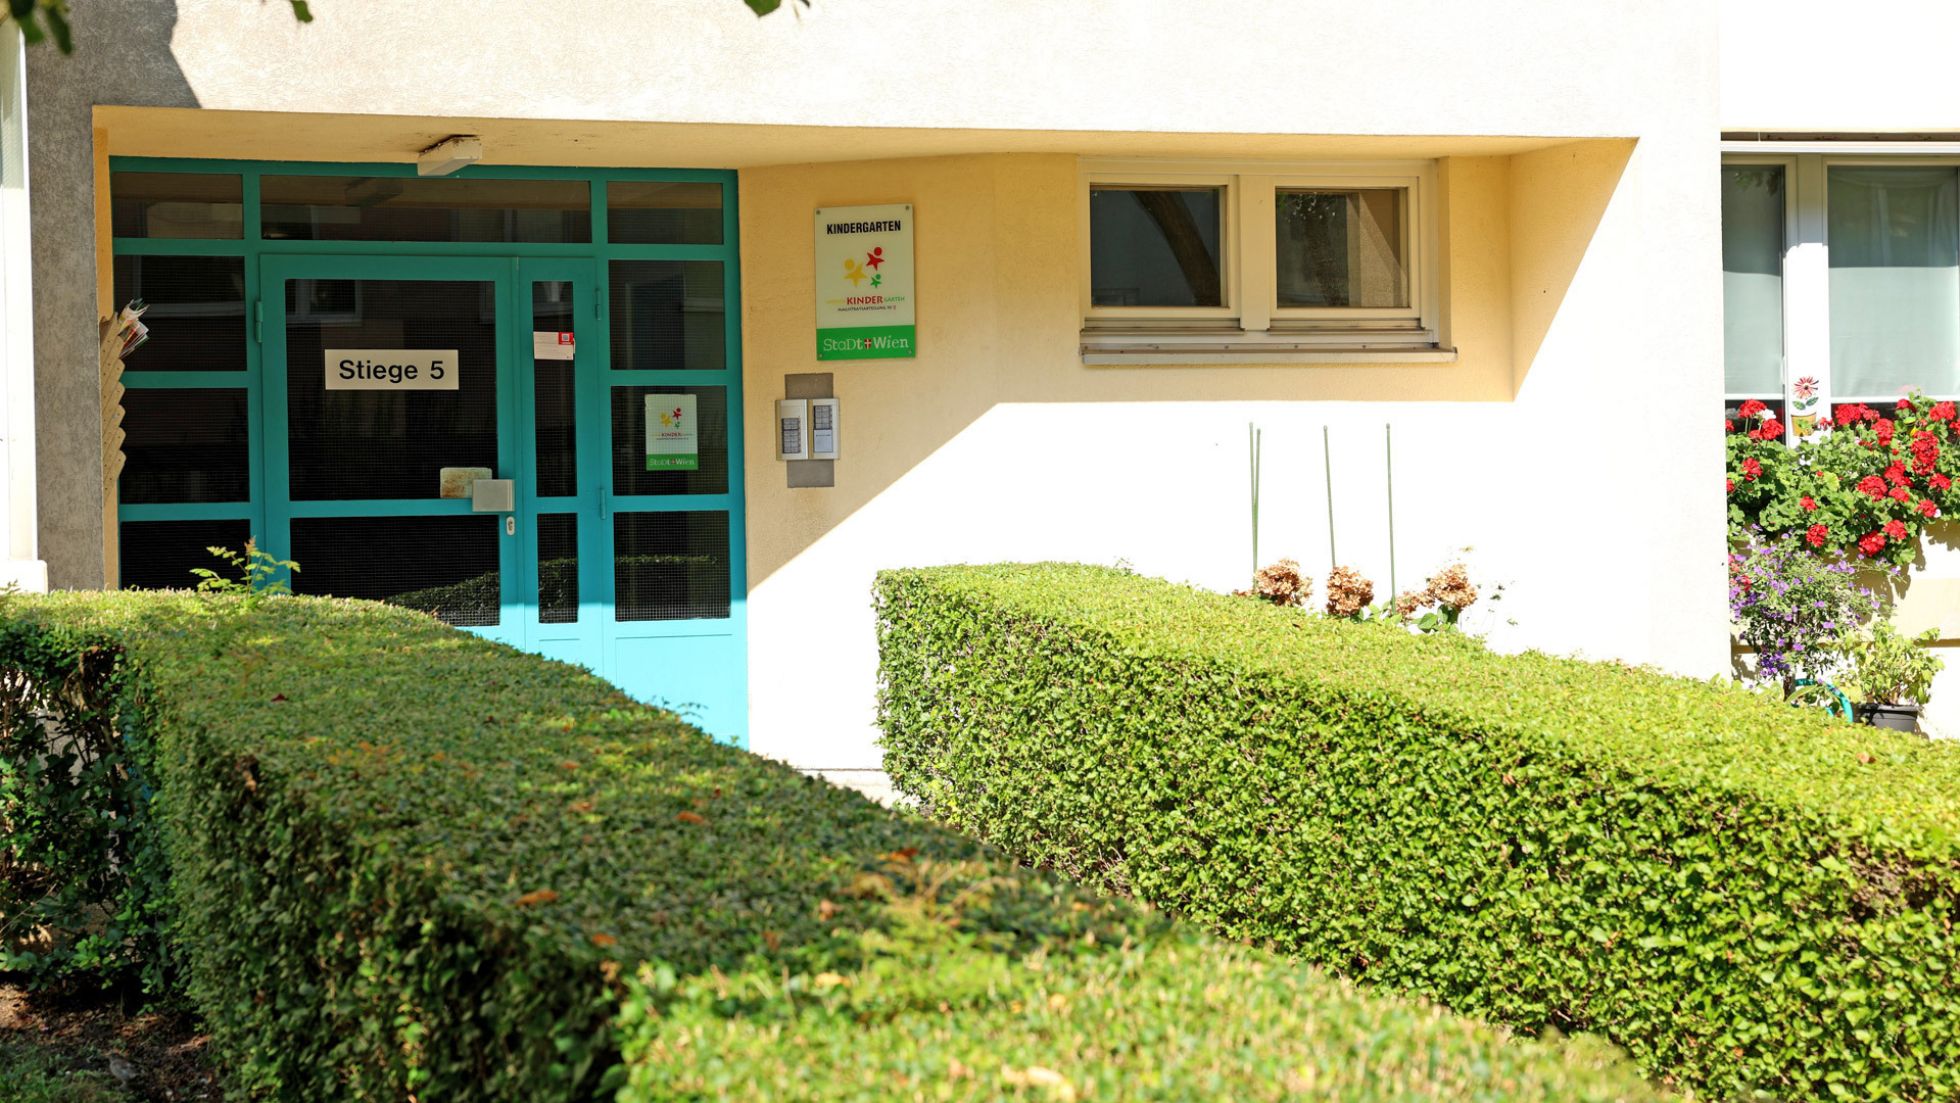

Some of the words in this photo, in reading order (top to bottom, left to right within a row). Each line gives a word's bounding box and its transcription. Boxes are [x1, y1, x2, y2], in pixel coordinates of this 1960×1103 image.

[826, 220, 901, 235] KINDERGARTEN
[846, 295, 883, 305] KINDER
[873, 335, 909, 349] Wien
[339, 359, 418, 384] Stiege
[430, 360, 445, 380] 5
